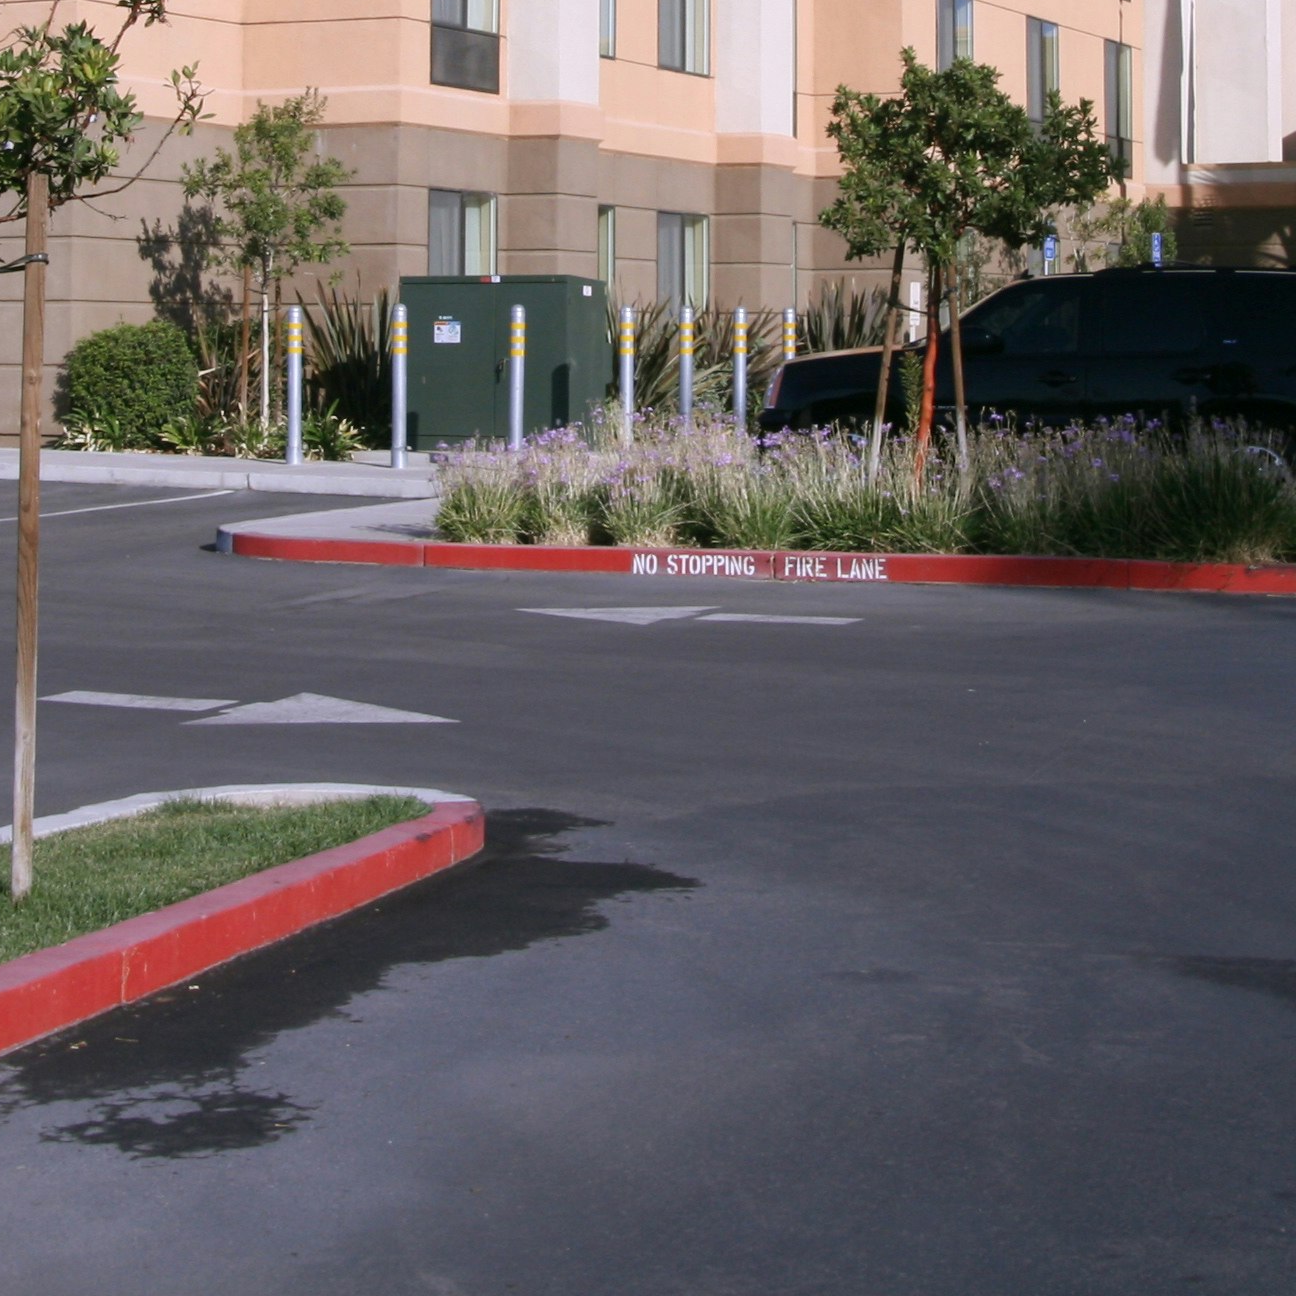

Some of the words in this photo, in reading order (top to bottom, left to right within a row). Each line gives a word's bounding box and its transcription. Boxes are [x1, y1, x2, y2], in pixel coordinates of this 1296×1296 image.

[632, 553, 657, 575] NO
[666, 553, 755, 576] STOPPING
[784, 556, 827, 578] FIRE
[836, 557, 887, 580] LANE
